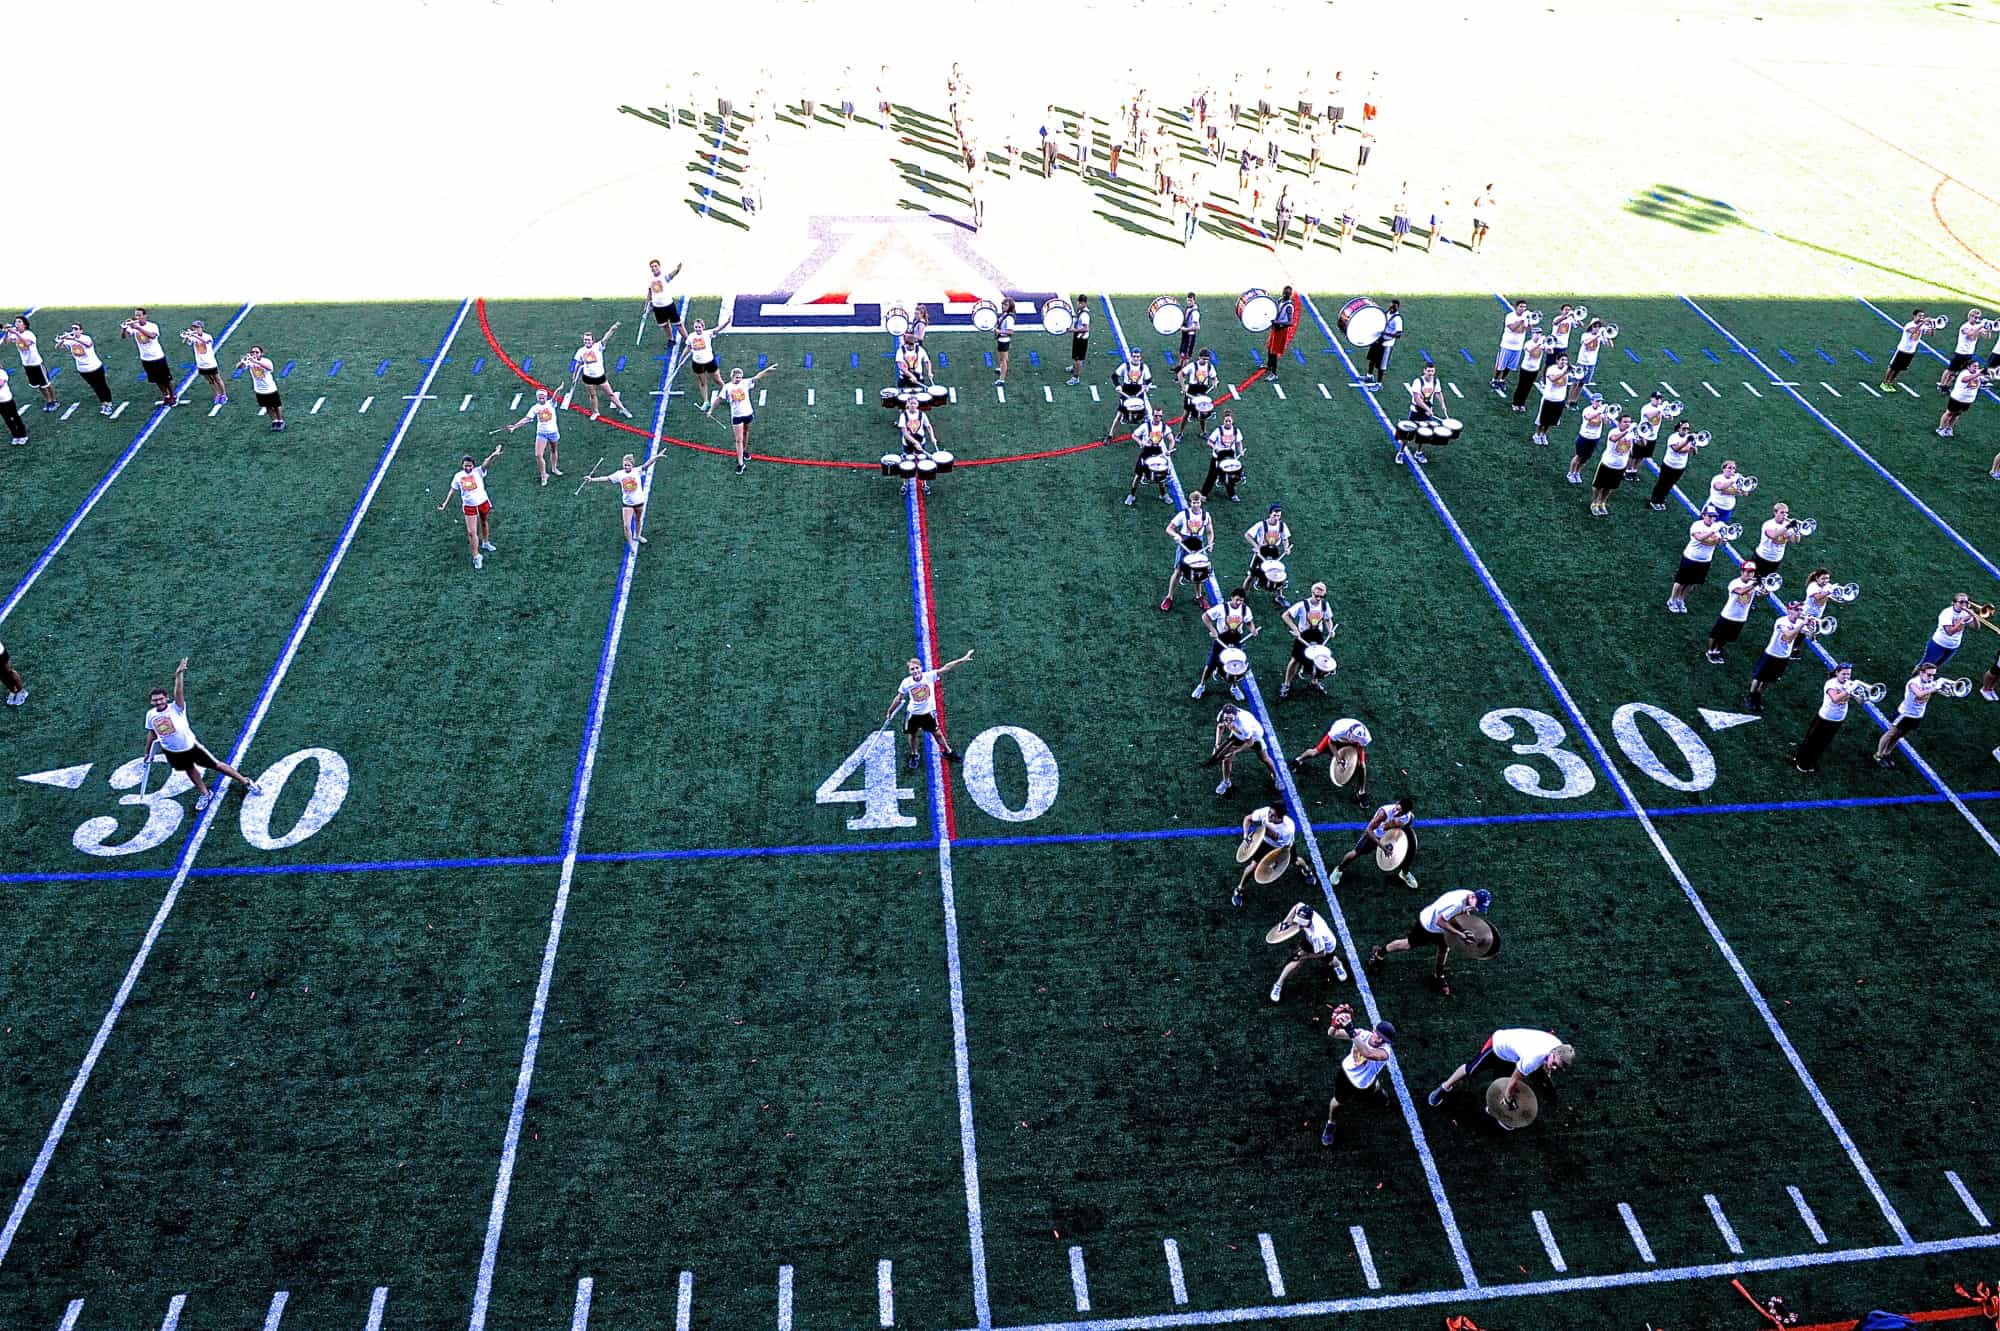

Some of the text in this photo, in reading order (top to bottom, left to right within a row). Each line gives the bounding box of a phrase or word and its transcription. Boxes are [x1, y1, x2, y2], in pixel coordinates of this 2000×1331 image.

[73, 747, 349, 856] 30
[816, 725, 1059, 830] 40
[1479, 702, 1716, 798] 30
